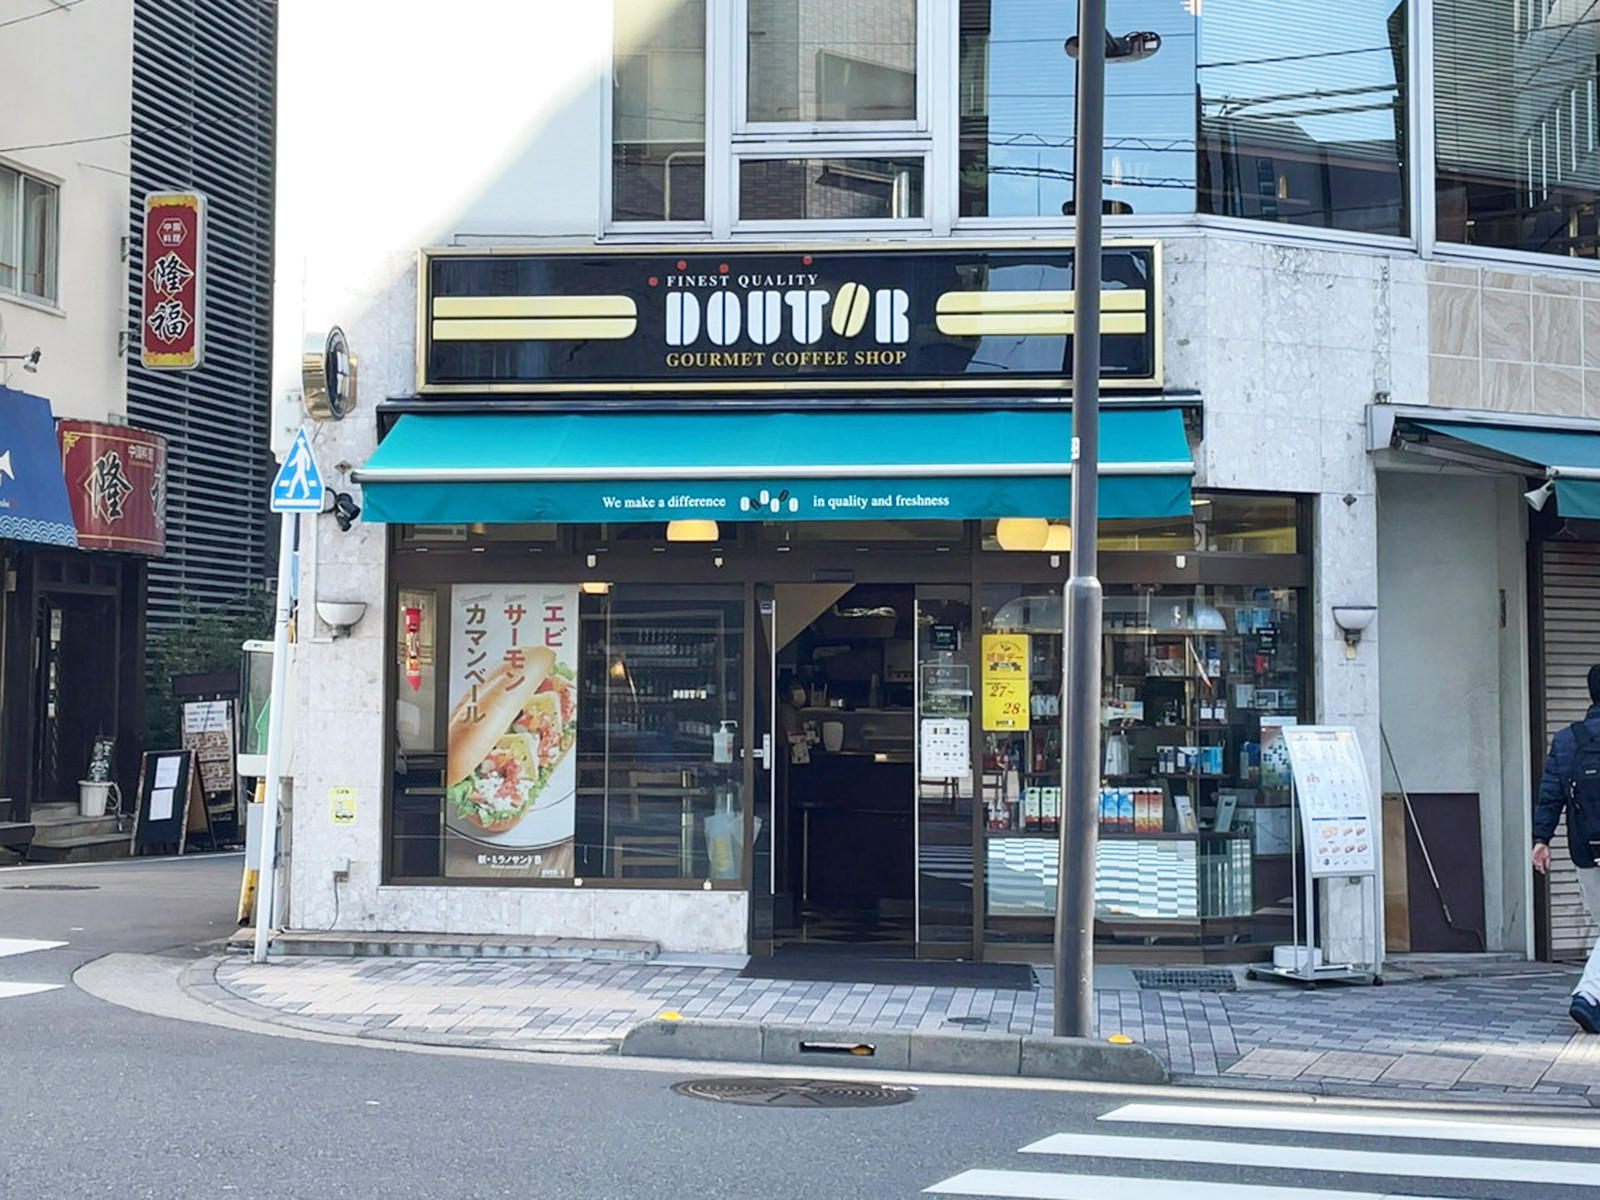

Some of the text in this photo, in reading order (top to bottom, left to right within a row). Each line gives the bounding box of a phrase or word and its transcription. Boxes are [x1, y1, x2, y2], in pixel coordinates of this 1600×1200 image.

[147, 254, 191, 340] 隆福
[666, 273, 819, 288] FINEST QUALITY
[665, 282, 910, 346] DOUTOR
[666, 350, 907, 367] GOURMET COFFEE SHOP
[602, 494, 950, 510] We make a difference in quality and freshness
[503, 604, 527, 692] サーモン
[543, 606, 567, 647] エビ
[461, 604, 488, 723] カマンベール
